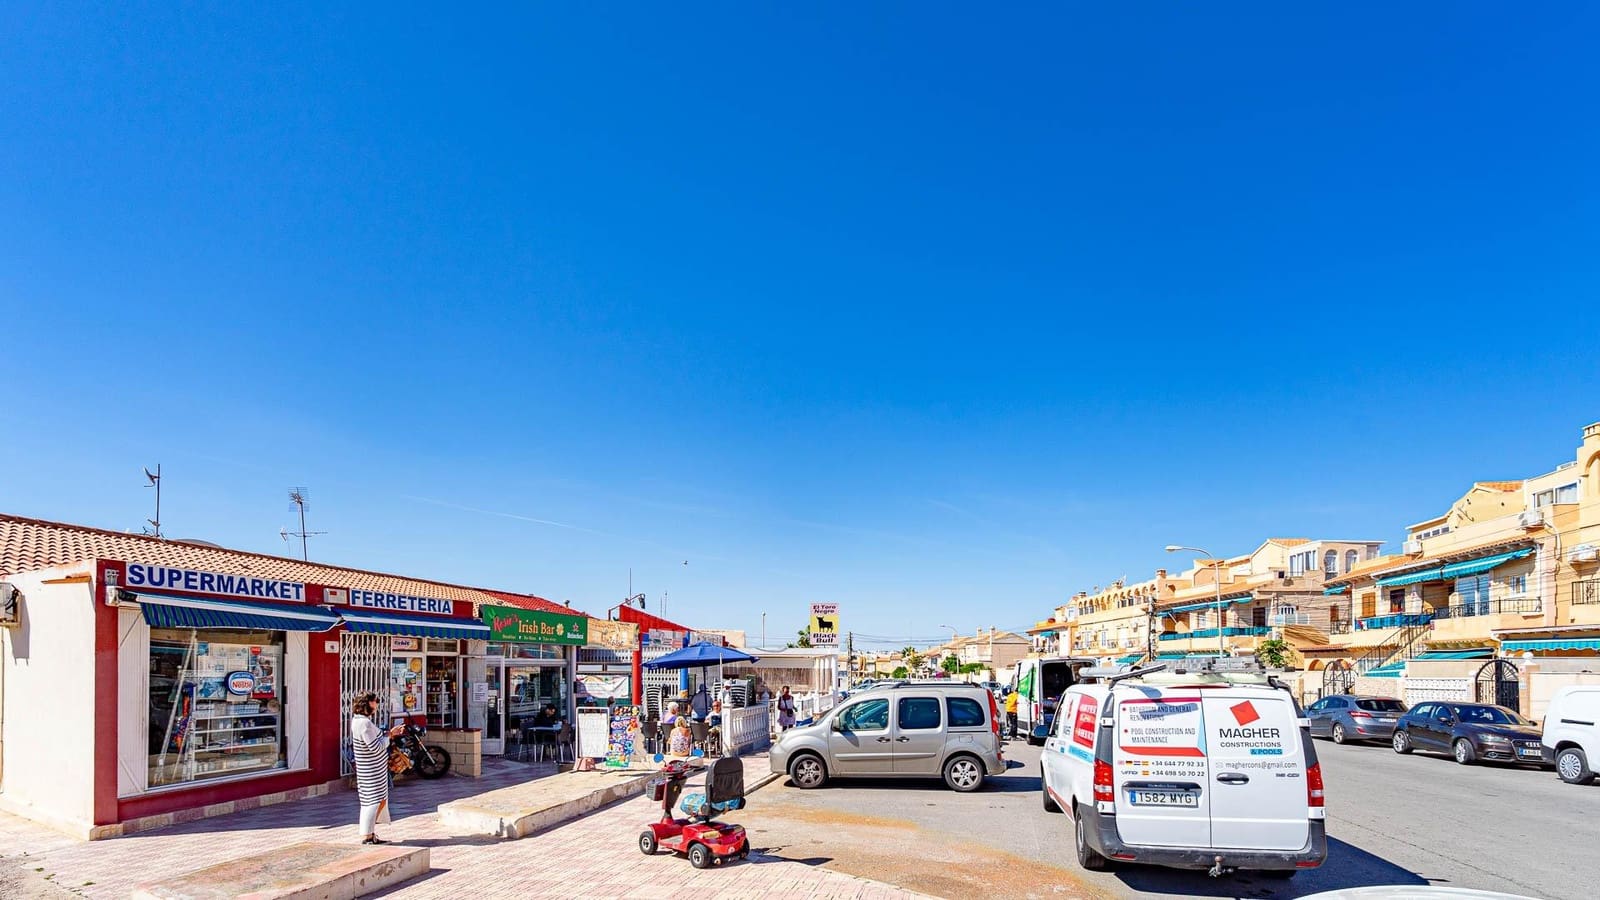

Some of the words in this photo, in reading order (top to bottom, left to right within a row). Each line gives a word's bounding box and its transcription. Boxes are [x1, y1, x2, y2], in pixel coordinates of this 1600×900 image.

[128, 564, 303, 600] SUPERMARKET
[352, 590, 451, 614] FERRETERIA
[519, 620, 538, 634] Irish
[541, 622, 555, 634] Bar
[1219, 728, 1280, 738] MAGHER
[1139, 793, 1166, 803] 1582
[1170, 794, 1192, 804] MYG
